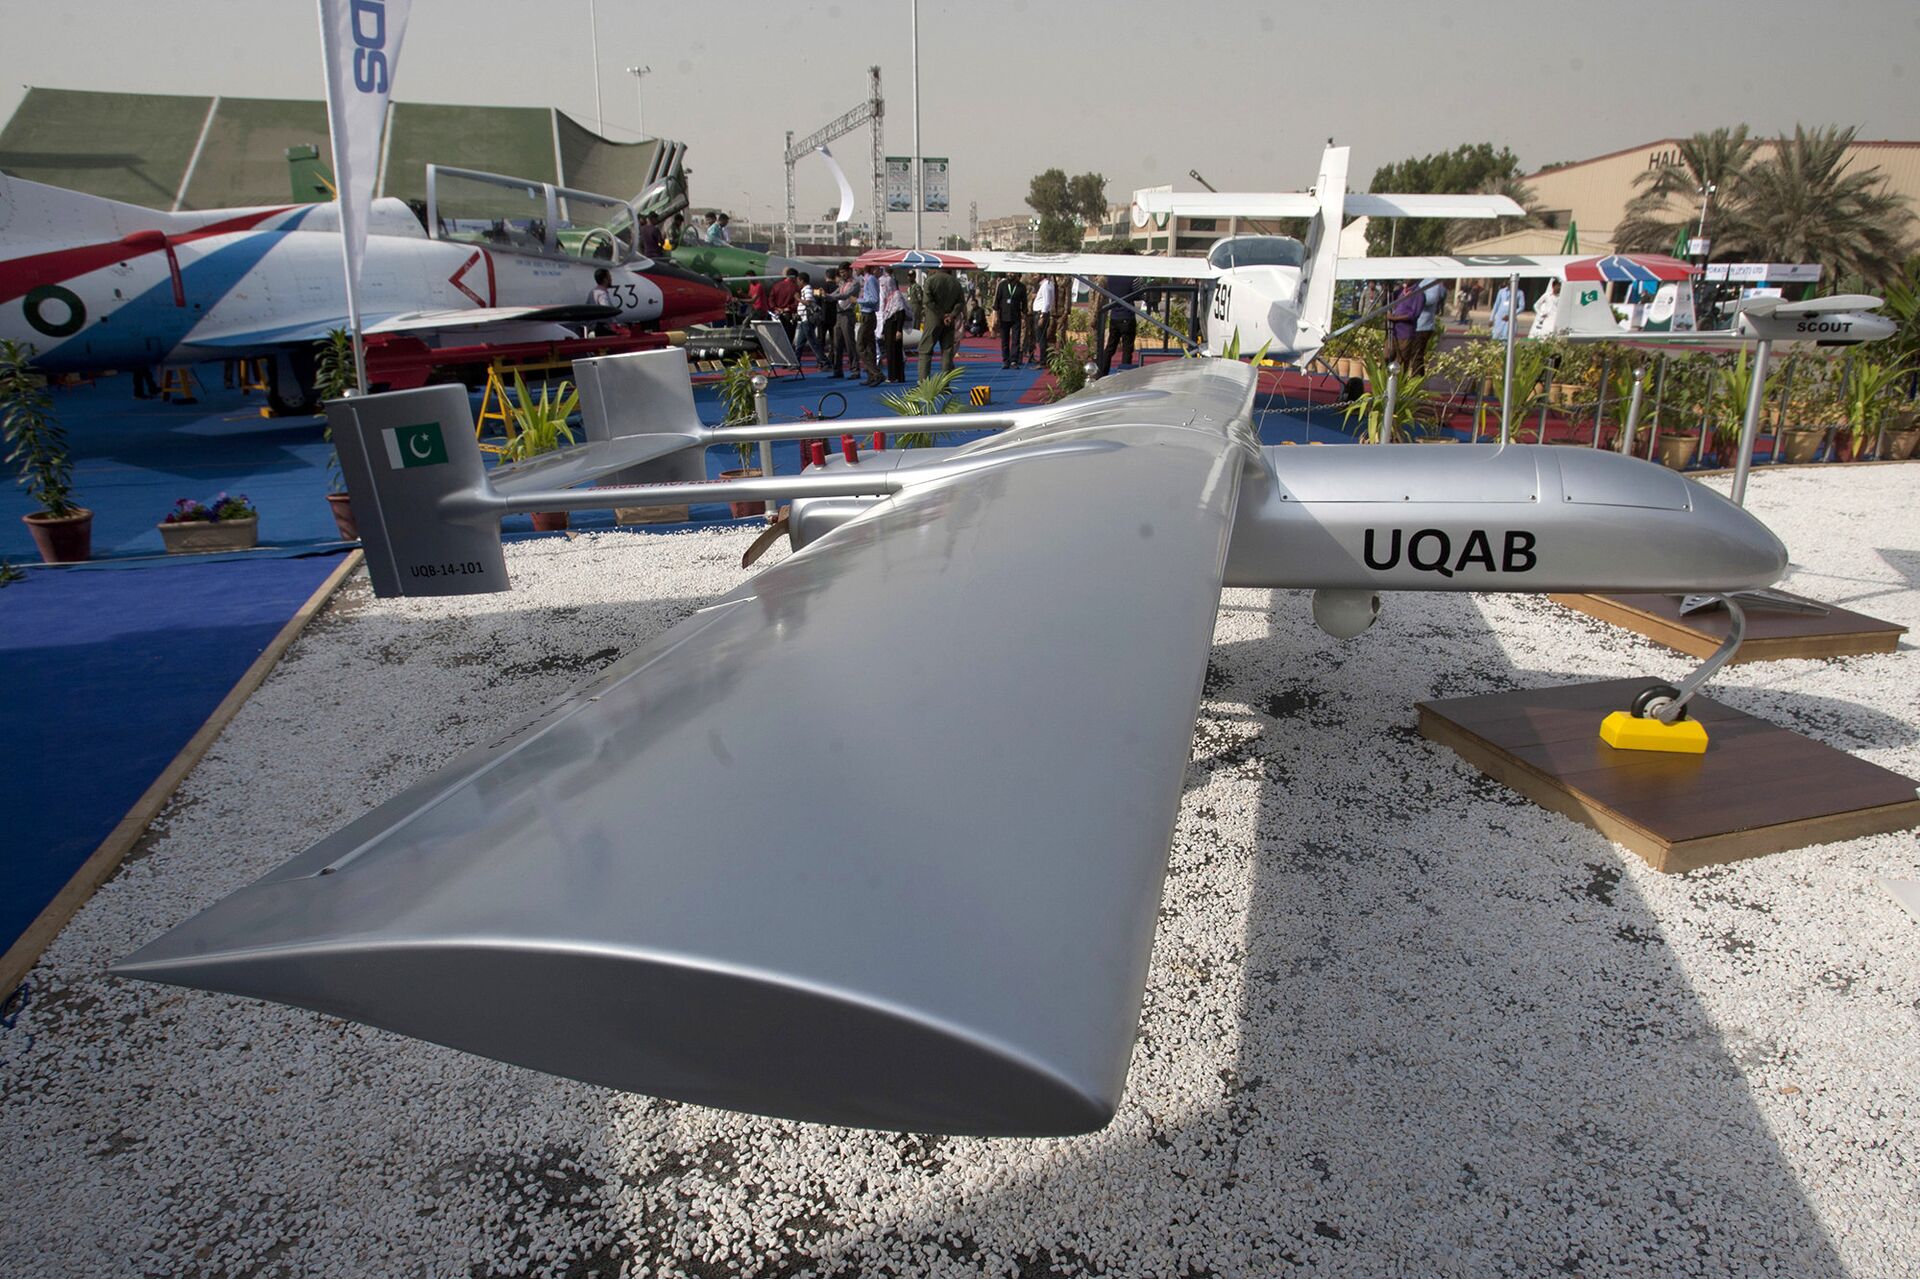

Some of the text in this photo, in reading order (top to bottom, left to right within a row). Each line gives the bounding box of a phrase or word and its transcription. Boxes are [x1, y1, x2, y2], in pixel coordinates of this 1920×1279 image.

[350, 0, 389, 94] DS
[1648, 149, 1685, 170] HALL
[1214, 283, 1232, 322] 391
[1796, 321, 1853, 333] SCOUT
[1364, 528, 1537, 578] UQAB
[410, 561, 484, 578] UQB-14-101
